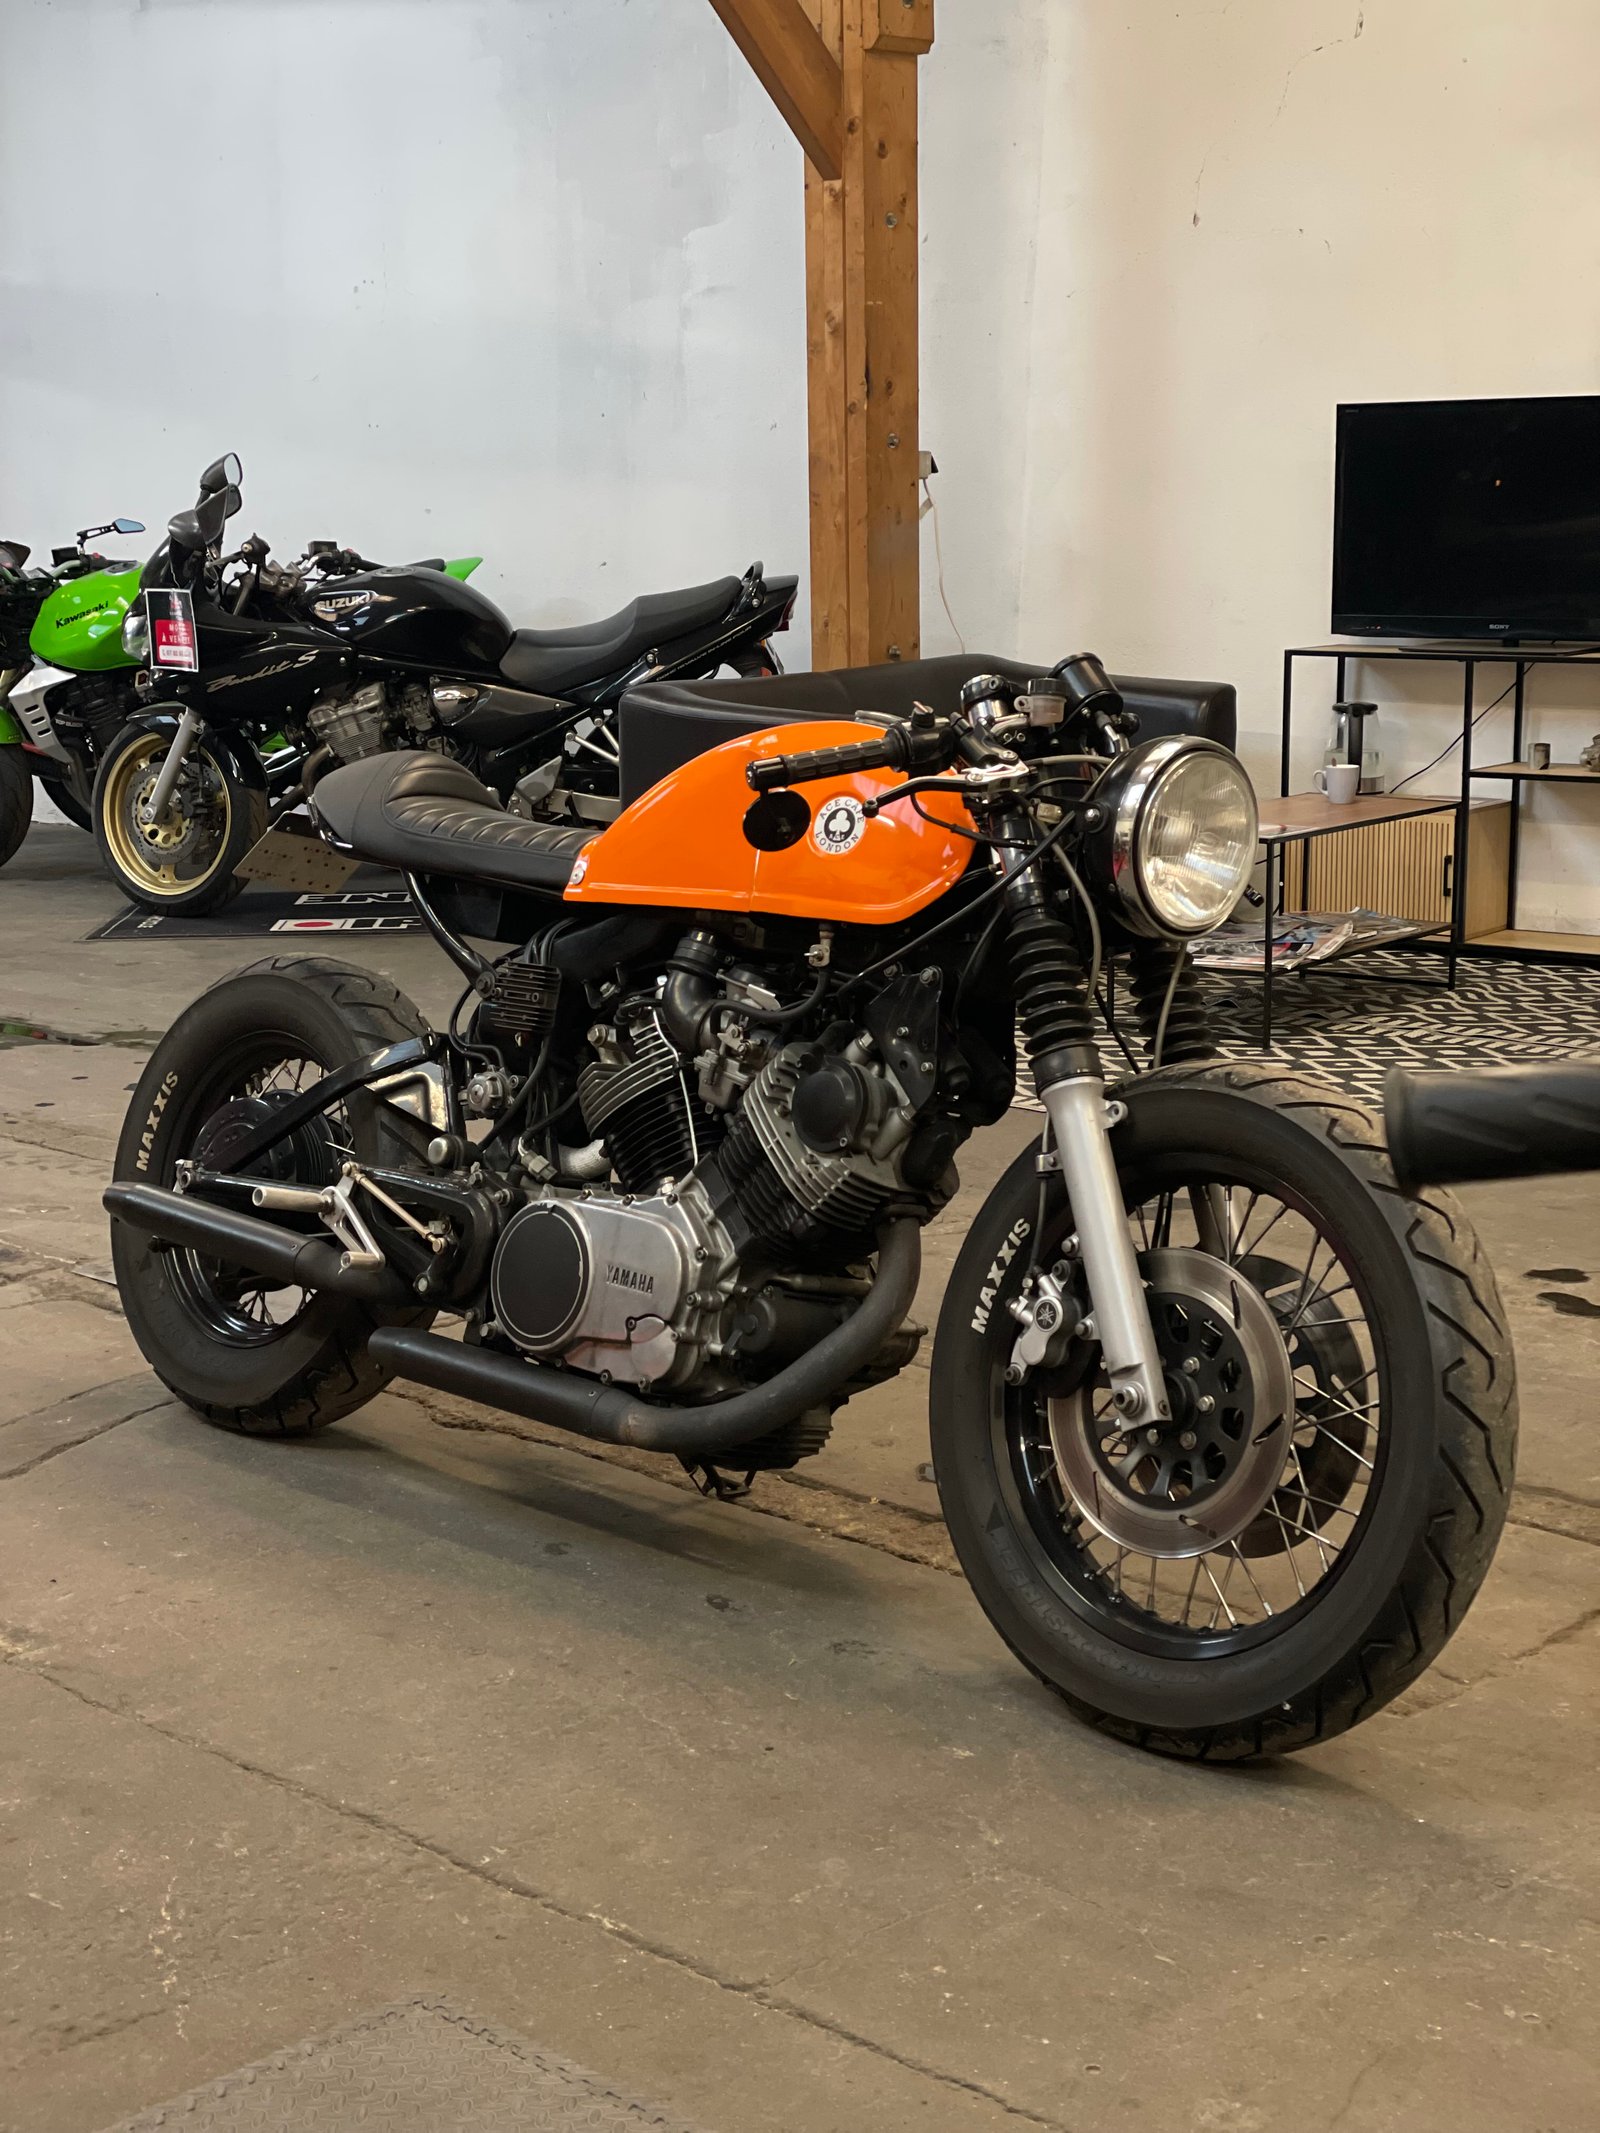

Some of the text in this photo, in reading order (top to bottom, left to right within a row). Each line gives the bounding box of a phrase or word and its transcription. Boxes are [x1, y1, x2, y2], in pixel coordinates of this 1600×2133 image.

[55, 600, 109, 629] Kawasaki
[314, 595, 370, 611] SUZUKI
[206, 649, 320, 693] Bandit S
[820, 799, 841, 820] ACE
[815, 831, 860, 853] LONDON
[136, 1071, 178, 1171] MAXXIS
[606, 1264, 654, 1294] YAMAHA
[971, 1218, 1031, 1334] MAXXIS
